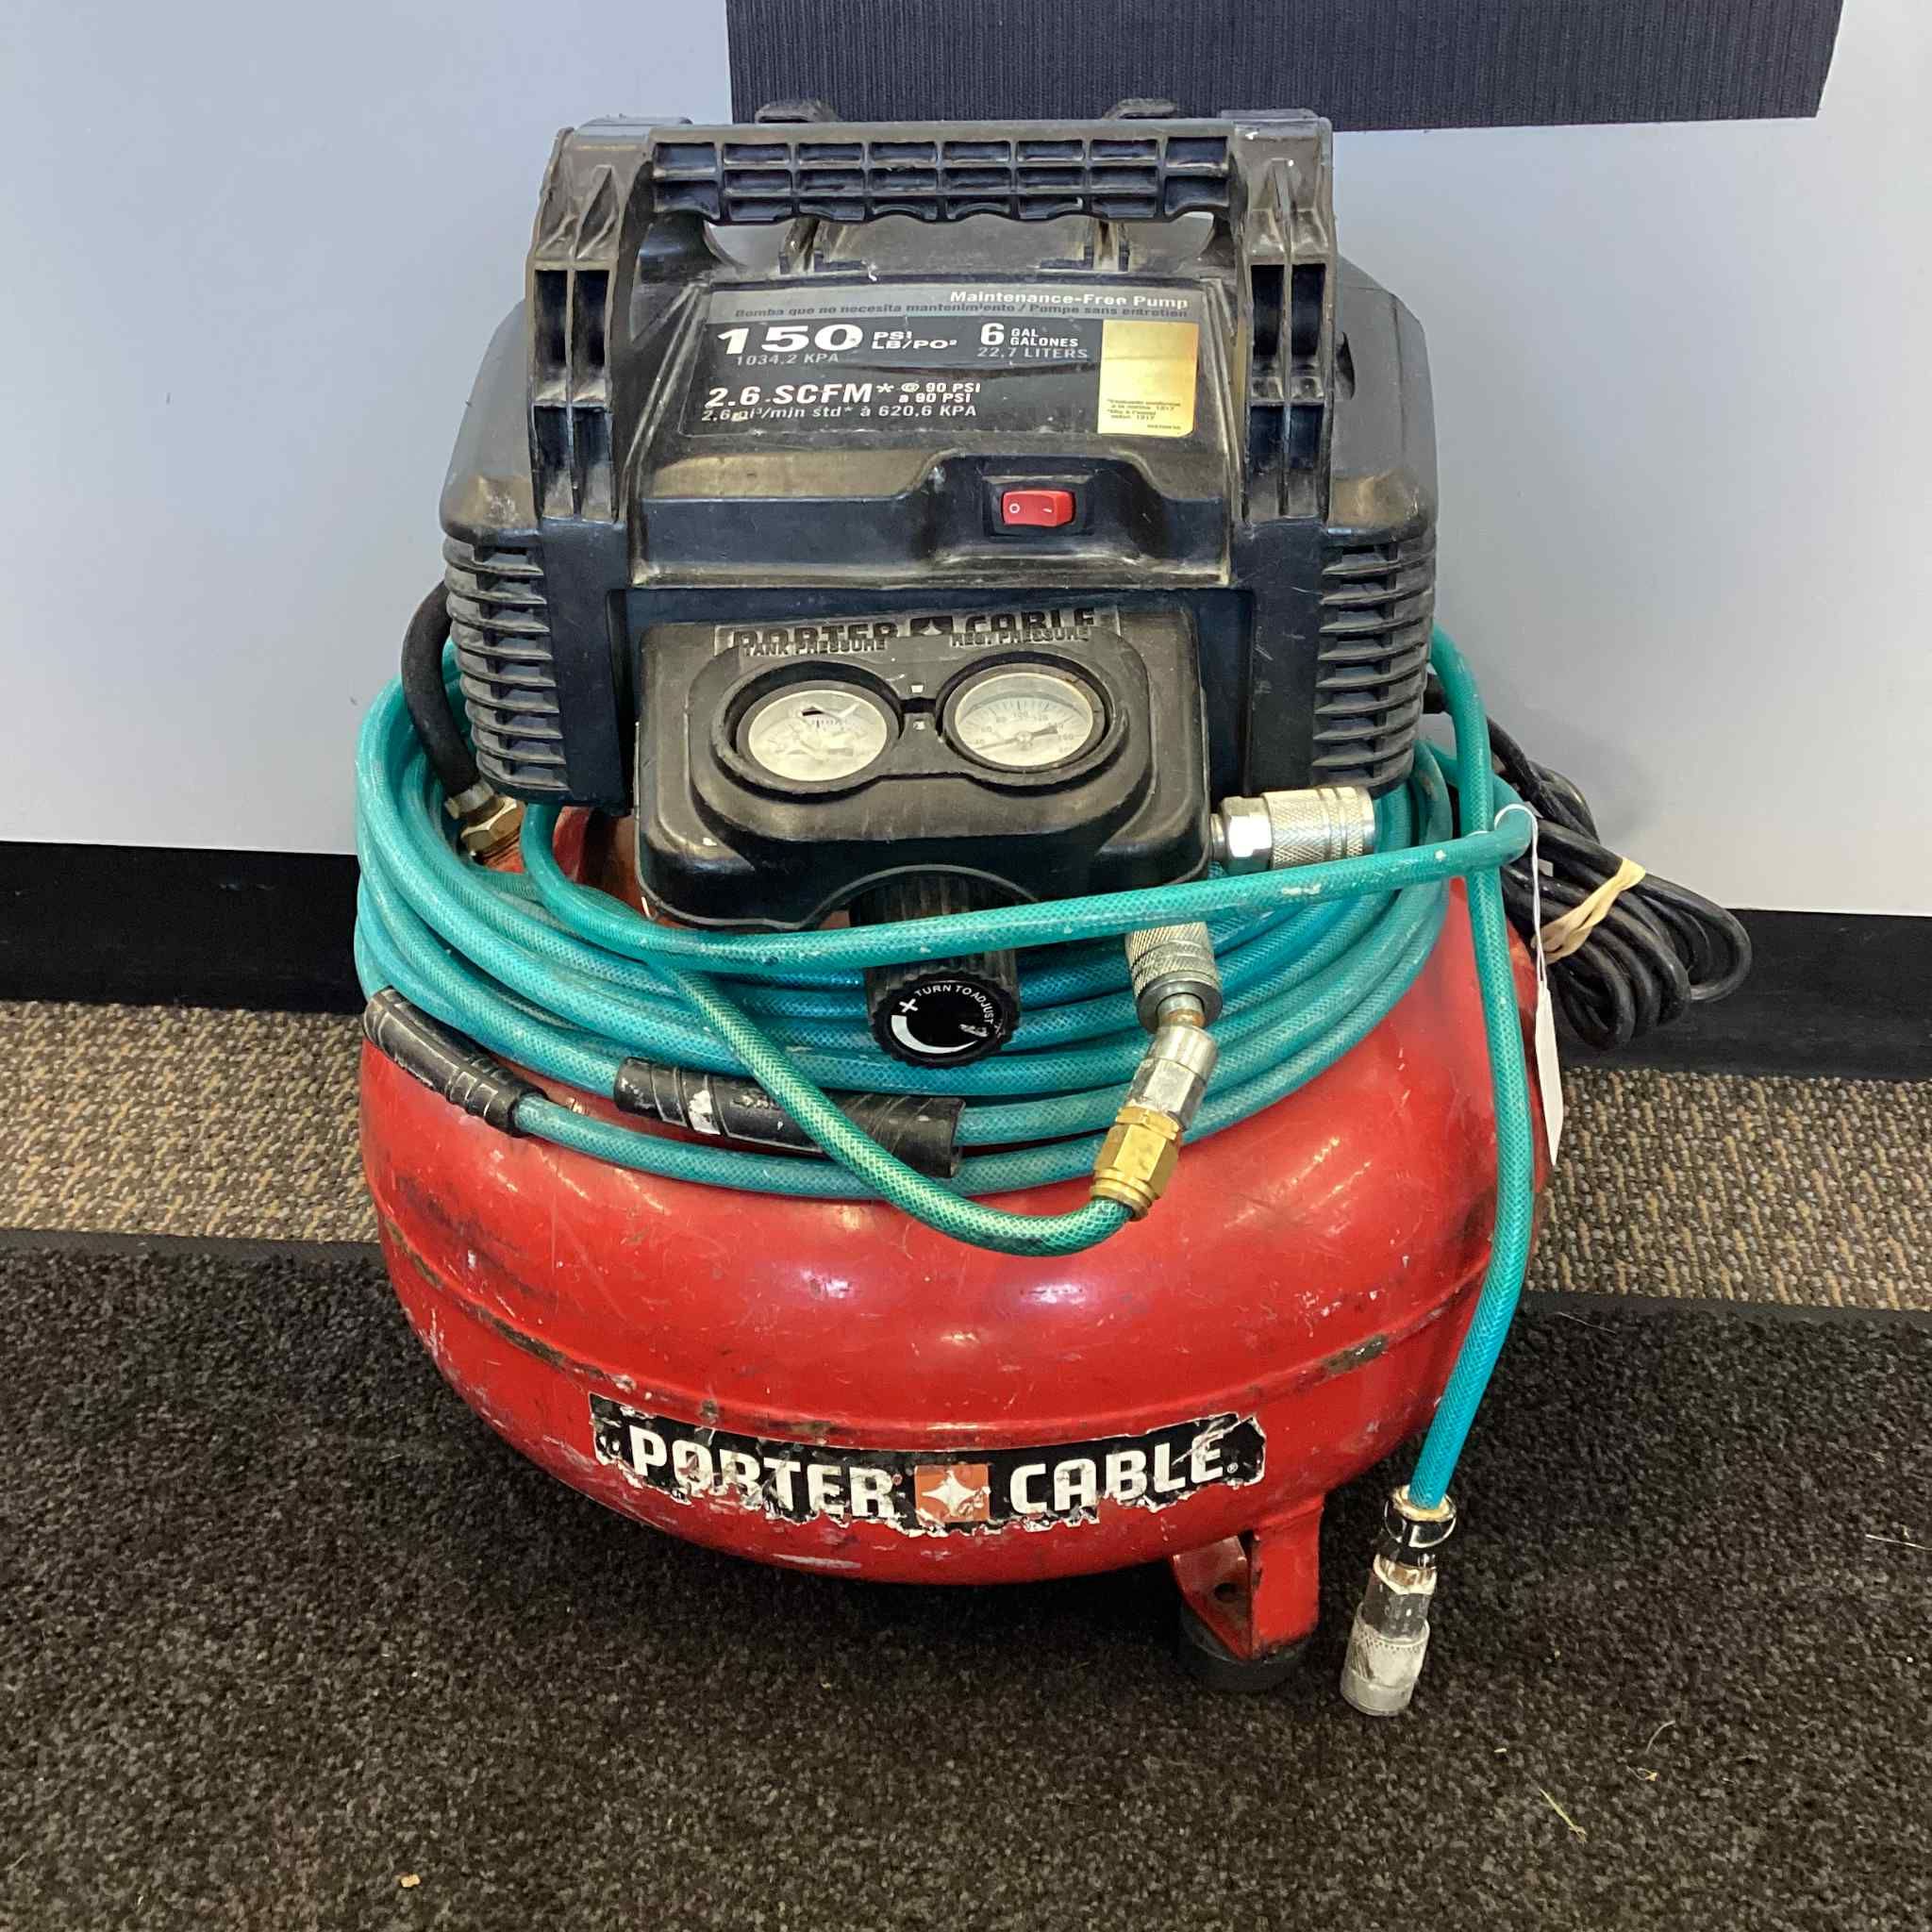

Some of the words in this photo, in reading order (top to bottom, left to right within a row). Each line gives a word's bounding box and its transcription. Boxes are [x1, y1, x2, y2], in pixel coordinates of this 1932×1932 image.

[950, 291, 1127, 305] Maintenance-Free
[1133, 294, 1188, 309] Pump
[736, 308, 784, 318] Bomba
[789, 308, 815, 316] que
[841, 303, 902, 313] necesita
[906, 303, 1015, 312] mantenimiento
[1029, 304, 1080, 314] Pompe
[1085, 307, 1118, 315] sans
[873, 330, 913, 341] PSI
[980, 323, 1005, 346] 6
[1010, 327, 1040, 338] GAL
[718, 324, 863, 355] 150
[1009, 337, 1079, 347] GALONES
[977, 347, 1017, 358] 22.7
[1024, 347, 1088, 358] LITERS
[737, 355, 798, 366] 1034.2
[804, 353, 840, 364] KPA
[925, 382, 947, 392] 90
[952, 382, 981, 393] PSI
[705, 386, 760, 408] 2.6
[941, 392, 972, 403] PSI
[878, 406, 932, 417] 620.6
[939, 405, 977, 416] KPA
[914, 984, 952, 997] TURN
[956, 985, 973, 996] TO
[970, 991, 993, 1024] ADJUST
[629, 1424, 898, 1519] PORTER
[1009, 1433, 1224, 1515] CABLE
